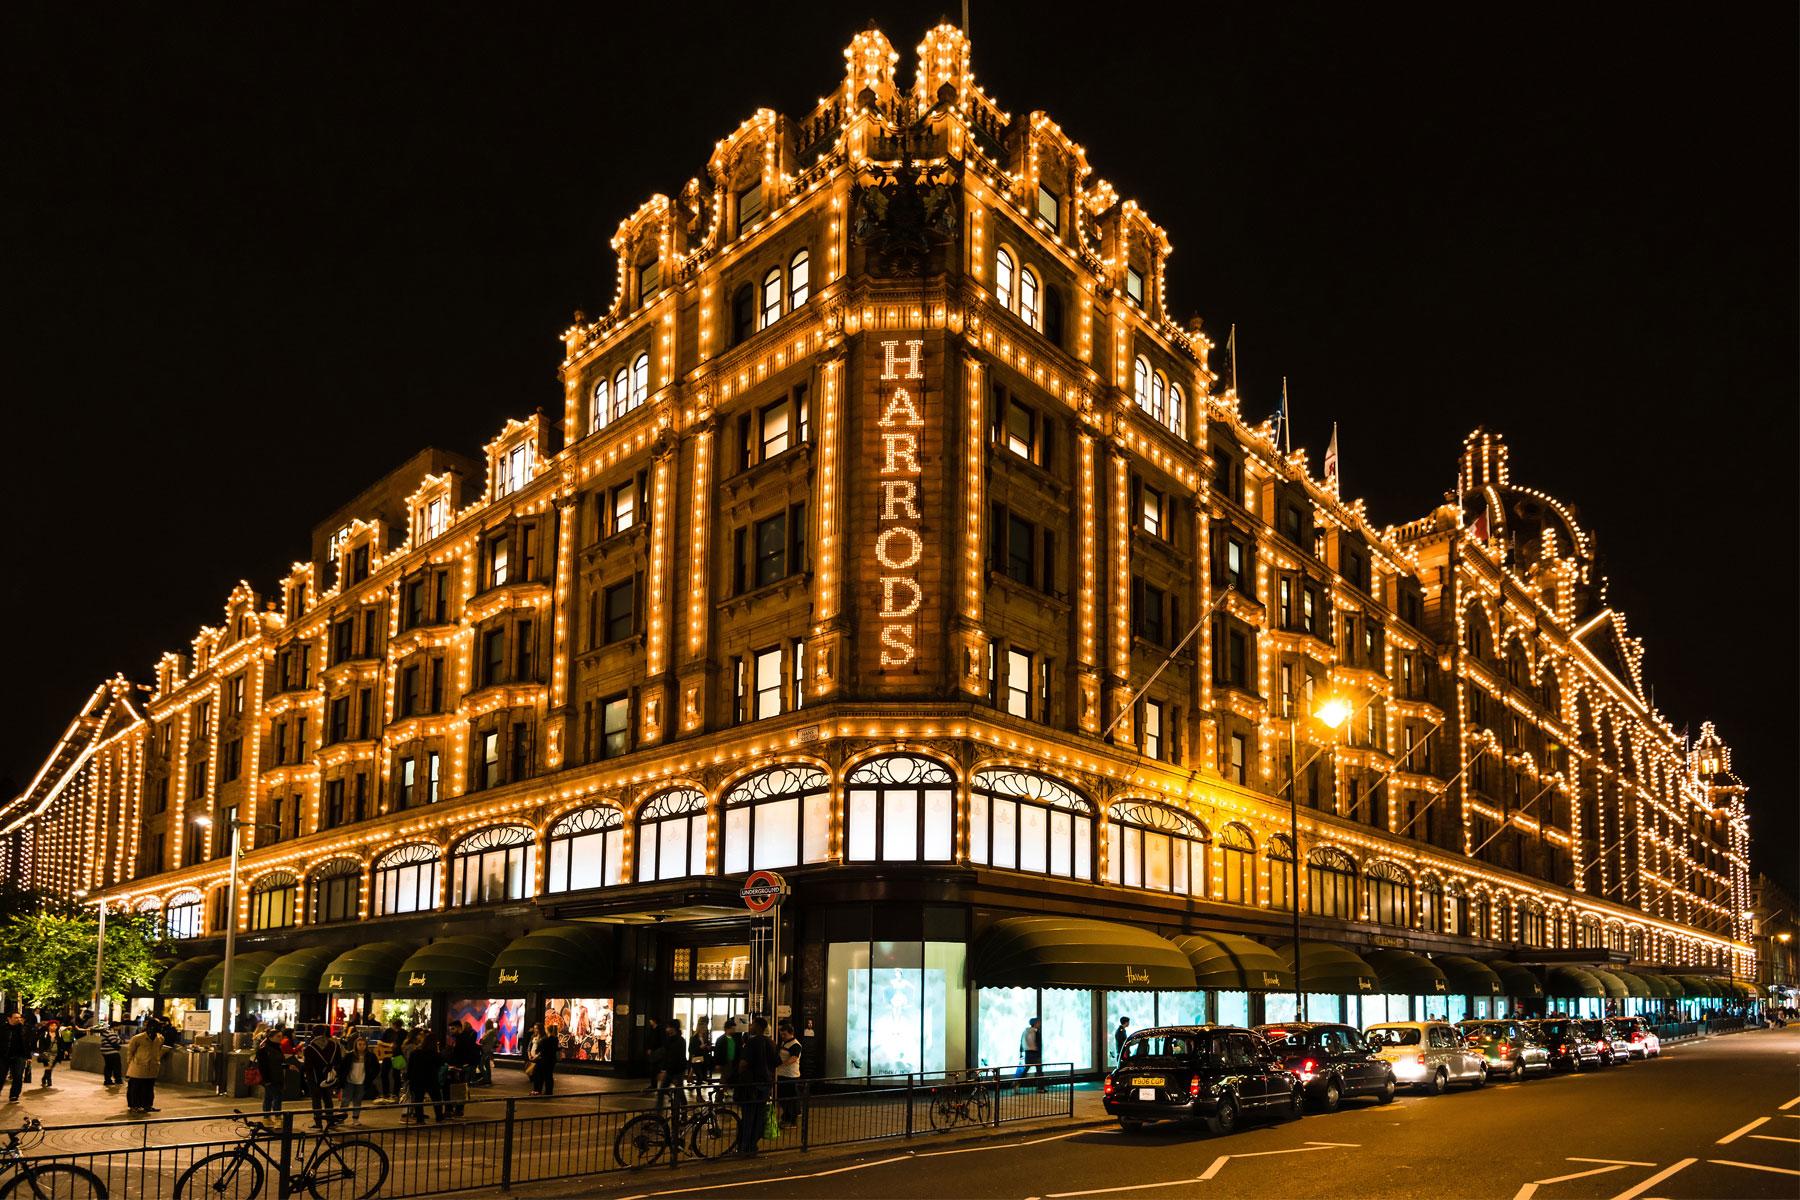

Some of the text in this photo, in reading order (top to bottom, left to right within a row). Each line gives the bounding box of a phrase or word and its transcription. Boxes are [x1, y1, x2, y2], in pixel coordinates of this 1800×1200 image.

[876, 339, 925, 665] HARRODS
[742, 887, 779, 895] UNDERGROUND
[1125, 966, 1149, 984] Harrods
